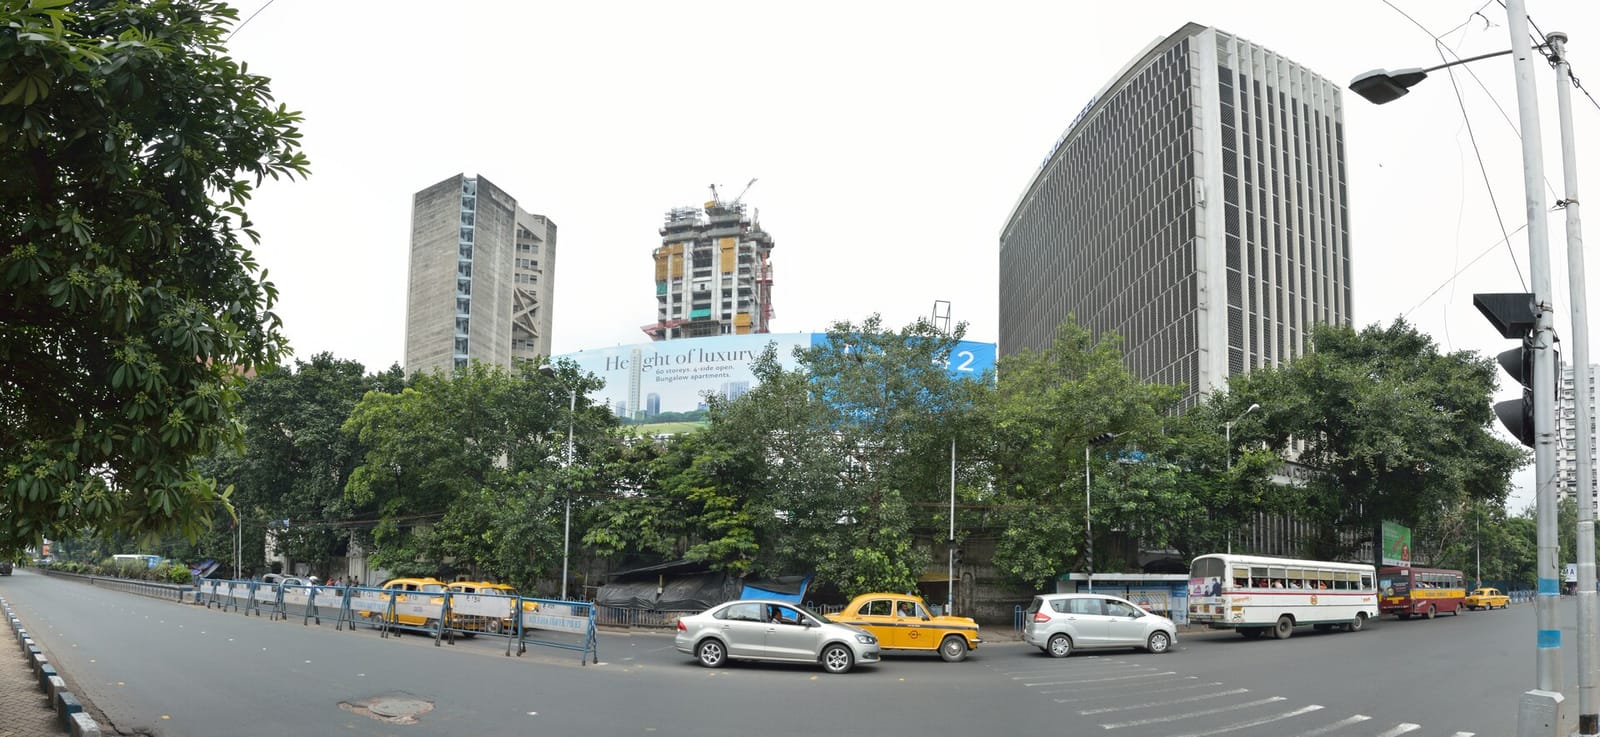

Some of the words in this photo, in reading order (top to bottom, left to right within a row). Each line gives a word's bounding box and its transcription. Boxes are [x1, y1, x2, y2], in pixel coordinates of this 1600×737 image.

[675, 348, 696, 364] of
[699, 347, 756, 365] luxury
[665, 366, 692, 376] storeys.
[715, 364, 735, 372] open.
[655, 374, 688, 383] Bungalow
[690, 372, 730, 381] apartments.
